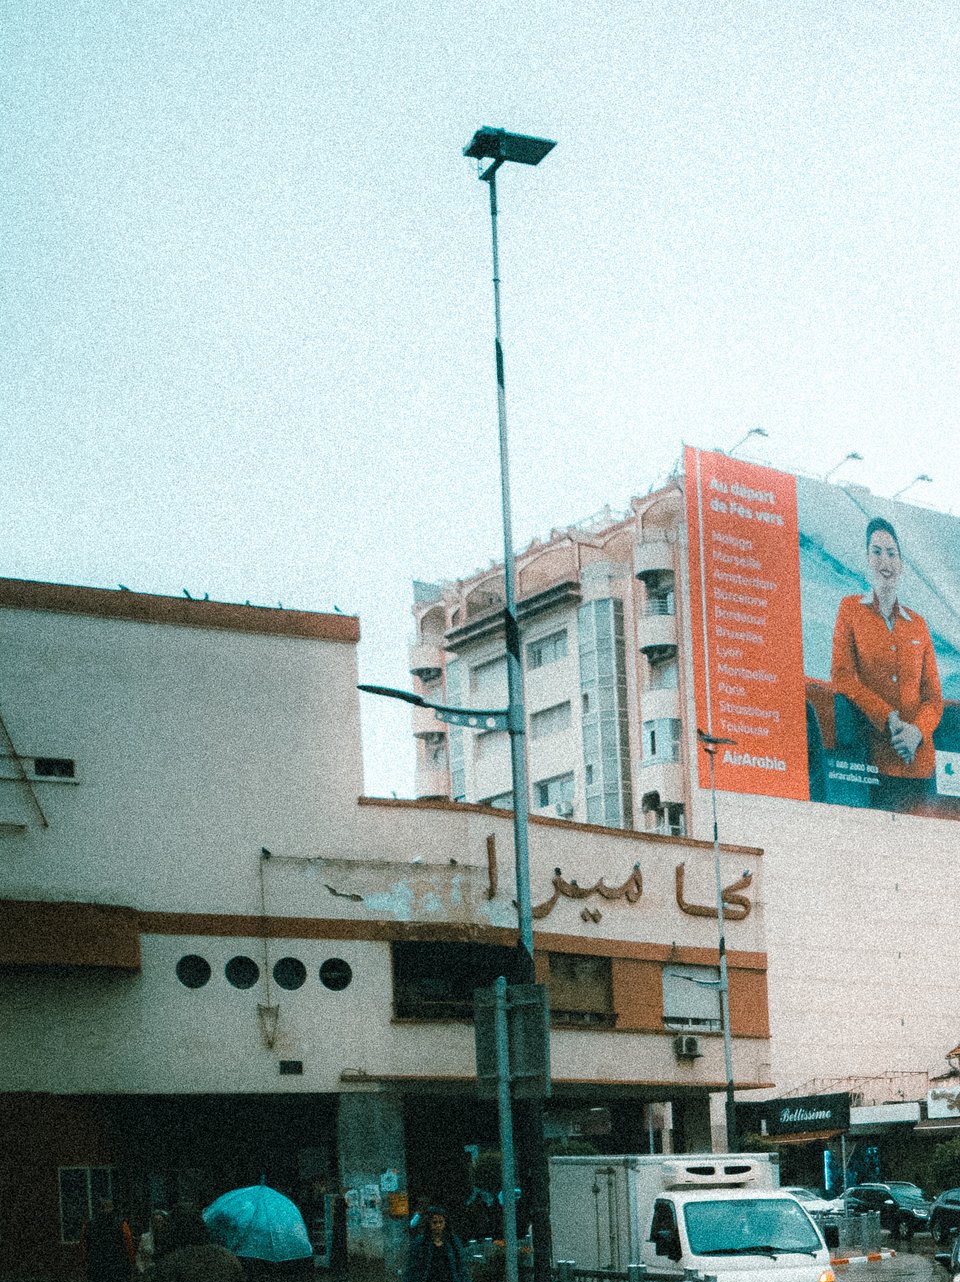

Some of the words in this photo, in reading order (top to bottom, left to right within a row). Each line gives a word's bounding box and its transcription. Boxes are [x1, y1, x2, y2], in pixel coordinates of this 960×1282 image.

[709, 476, 728, 493] Au
[709, 497, 727, 514] de
[755, 510, 785, 526] vers
[715, 624, 765, 645] Bruxelles
[716, 645, 743, 659] Lyon
[718, 681, 745, 697] Paris
[720, 718, 770, 737] Toulouse
[722, 750, 786, 772] AirArabia
